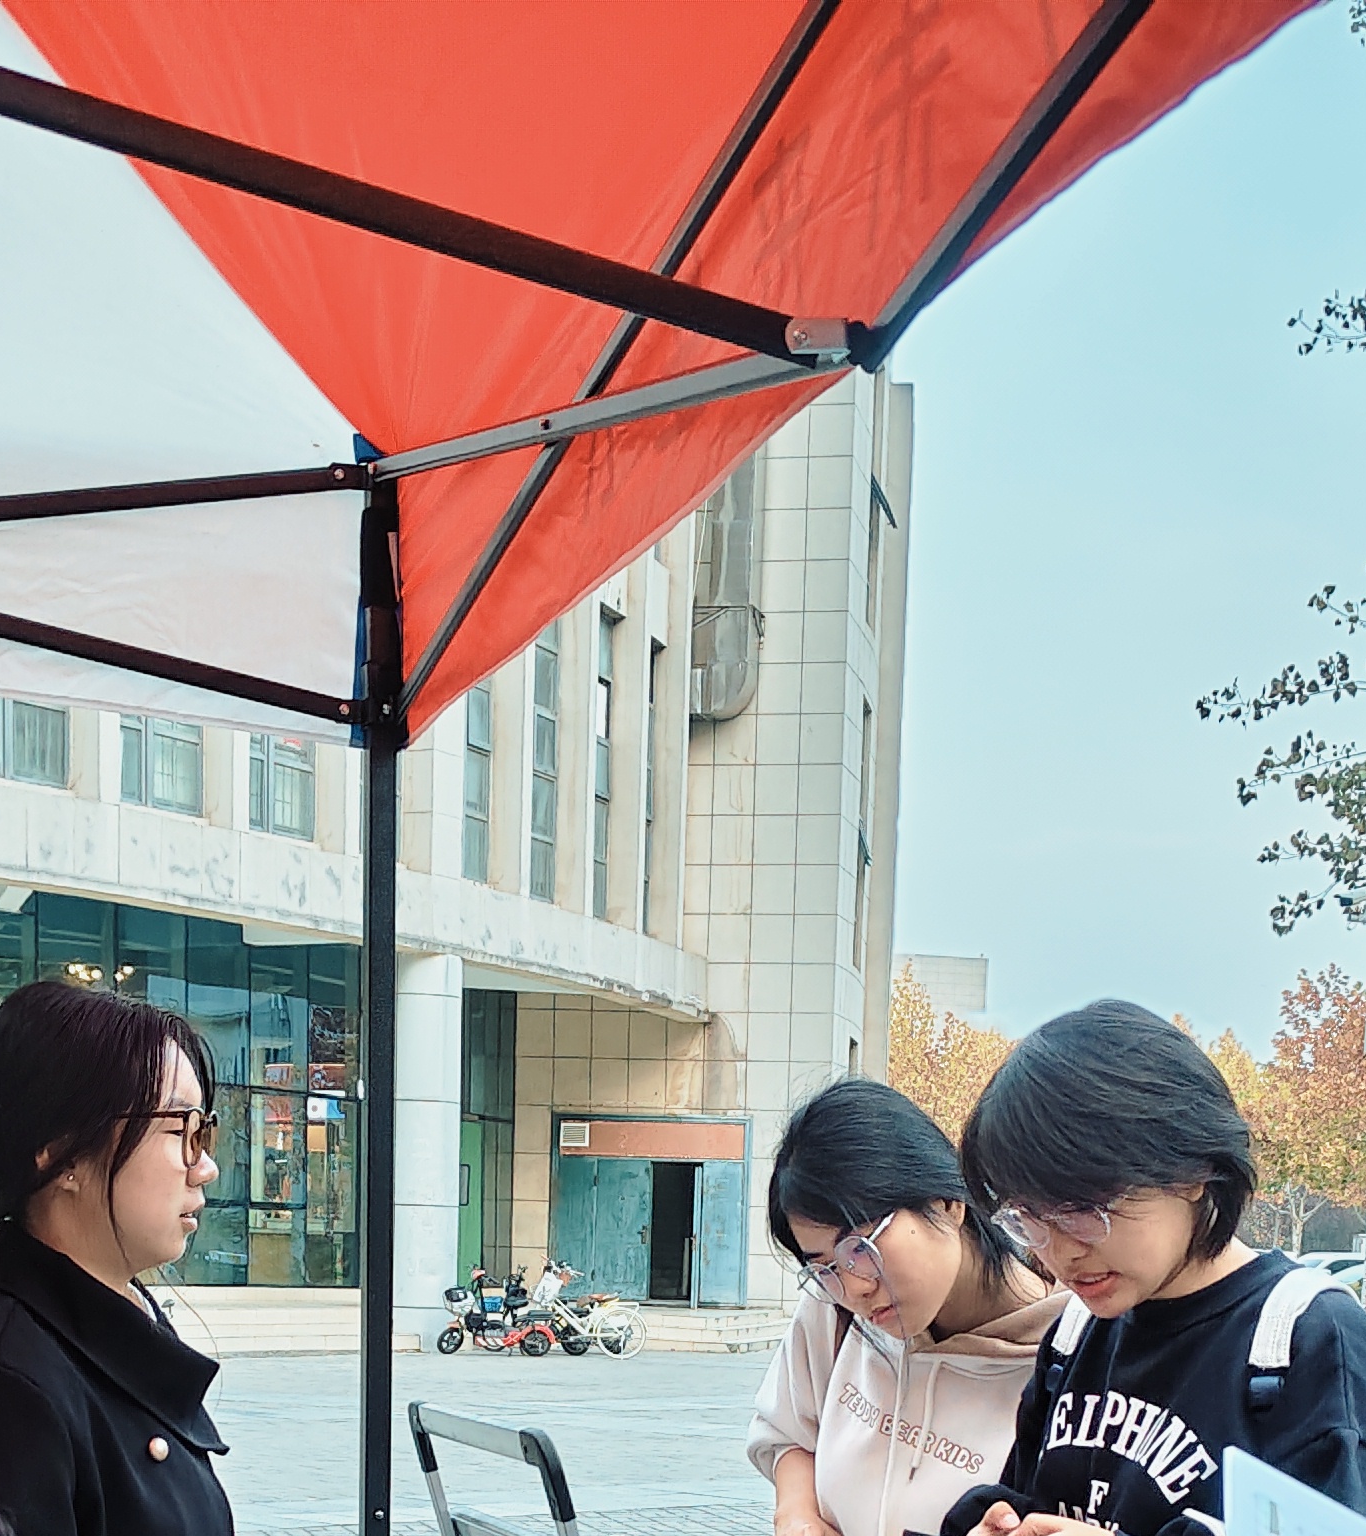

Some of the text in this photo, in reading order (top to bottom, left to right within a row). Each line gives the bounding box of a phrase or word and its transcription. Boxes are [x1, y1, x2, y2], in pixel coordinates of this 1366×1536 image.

[839, 1382, 985, 1475] TEDDY BEAR KIDS
